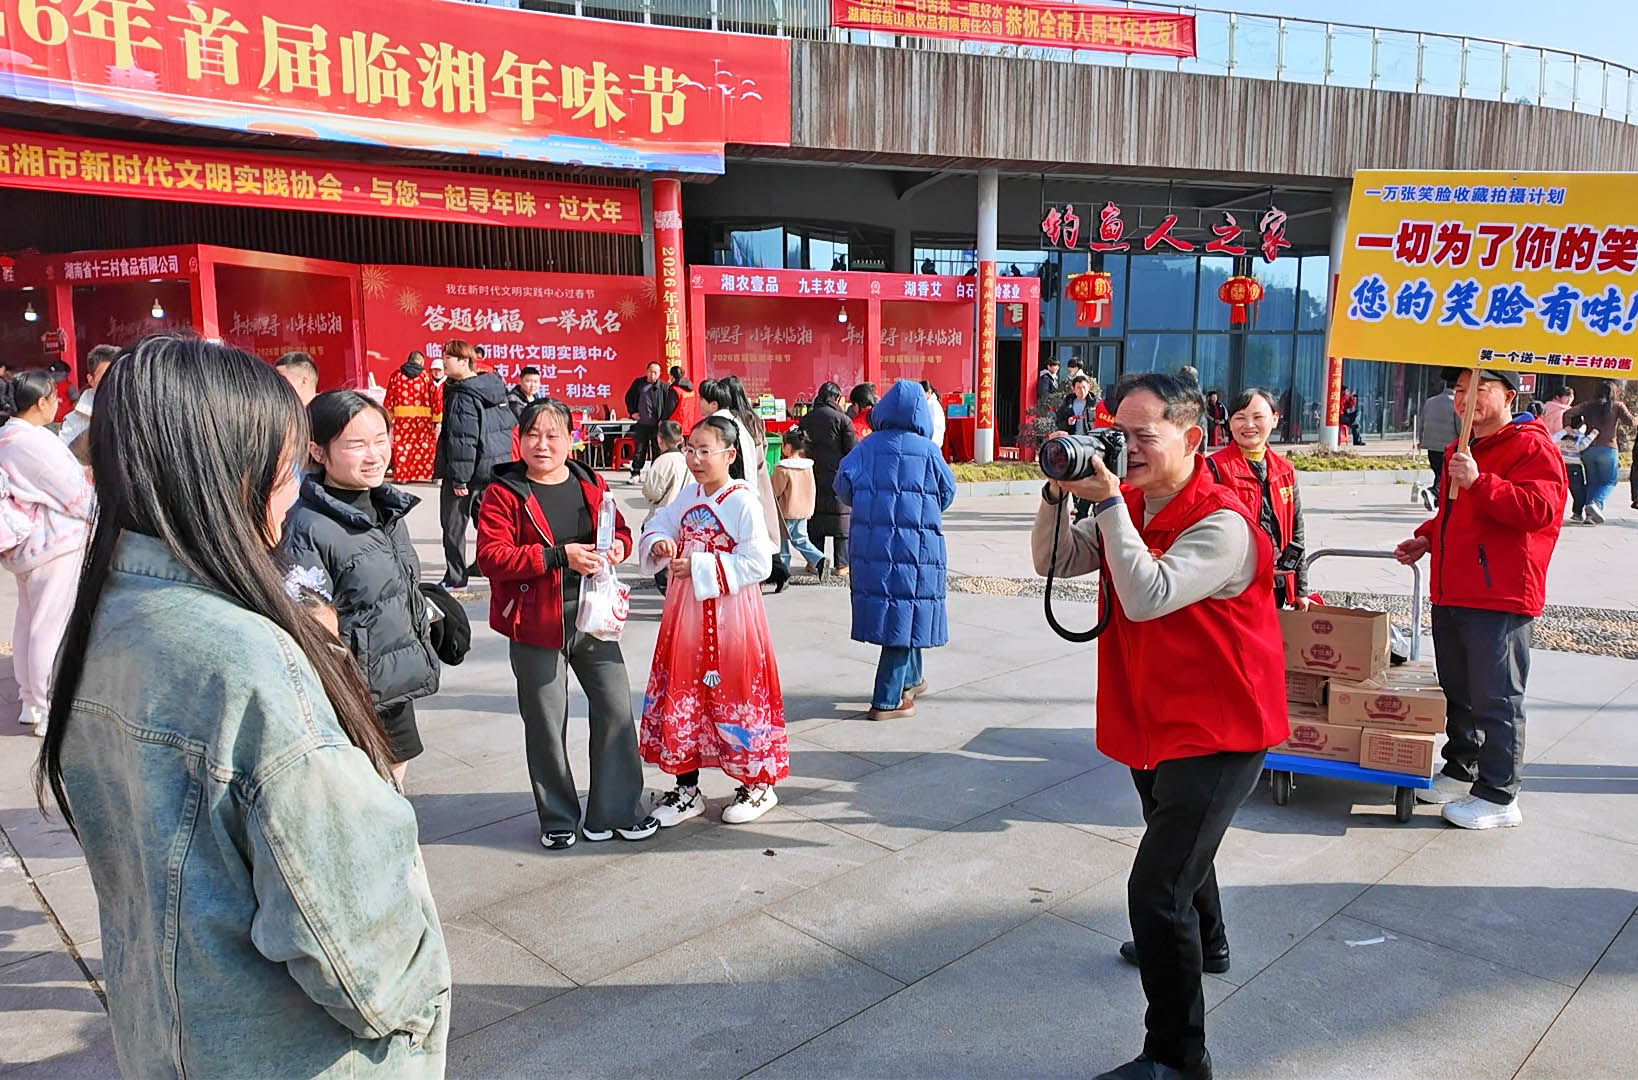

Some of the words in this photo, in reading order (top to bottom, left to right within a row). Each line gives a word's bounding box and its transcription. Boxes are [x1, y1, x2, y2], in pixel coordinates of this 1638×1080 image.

[957, 4, 1003, 18] 一瓶好水
[0, 0, 690, 134] 6年首届临湘年味节
[1364, 185, 1566, 205] 一万张笑脸收藏拍摄计划
[1042, 201, 1291, 262] 钓鱼人之家
[1356, 222, 1638, 273] 一切为了你的笑
[64, 255, 179, 280] 湖南省十三村食品有限公司
[446, 283, 596, 299] 我在新时代文明实践中心过春节
[720, 274, 779, 293] 湘农壹品
[798, 278, 848, 295] 九丰农业
[904, 280, 942, 297] 湖香艾
[421, 304, 525, 334] 答题纳福
[537, 308, 623, 336] 一举成名
[426, 342, 617, 361] 临新时代文明实践中心
[1480, 349, 1632, 370] 笑一个送一瓶十三村的酱
